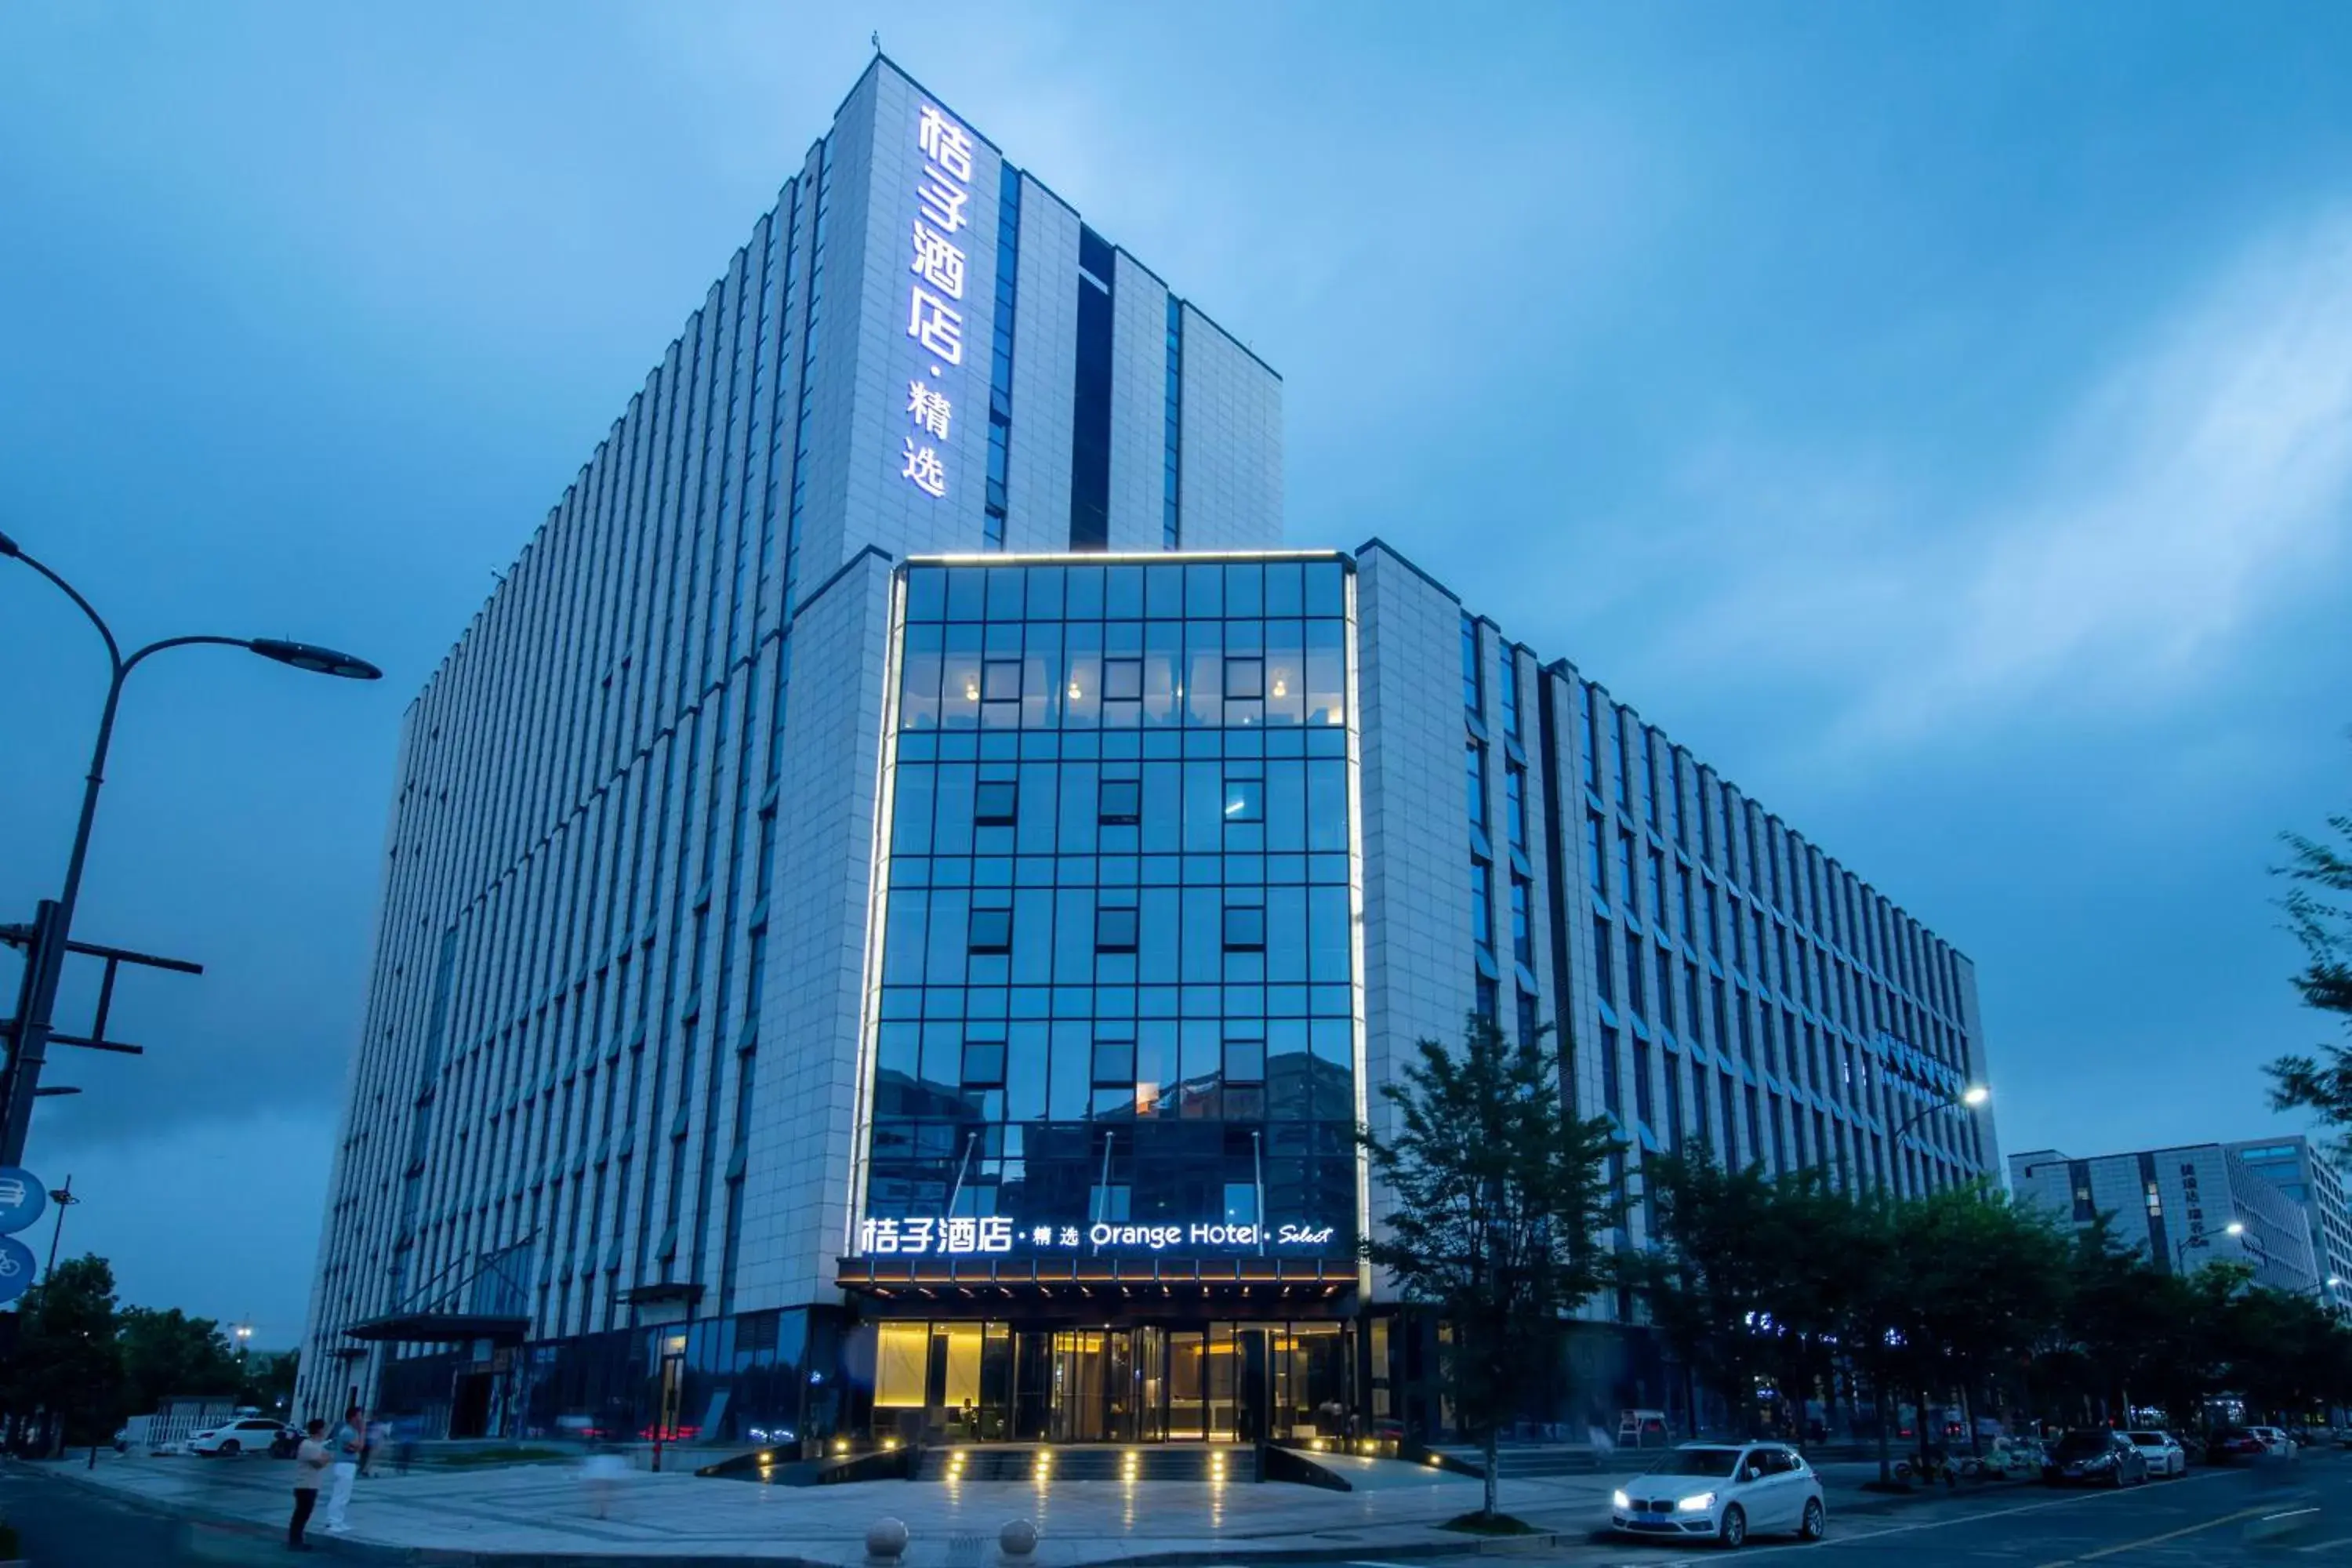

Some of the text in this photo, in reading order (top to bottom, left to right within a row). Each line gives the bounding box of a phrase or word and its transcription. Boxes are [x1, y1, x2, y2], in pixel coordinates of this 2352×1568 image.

[1091, 1224, 1181, 1248] Orange
[1191, 1223, 1258, 1244] Hotel
[1278, 1225, 1334, 1244] Select
